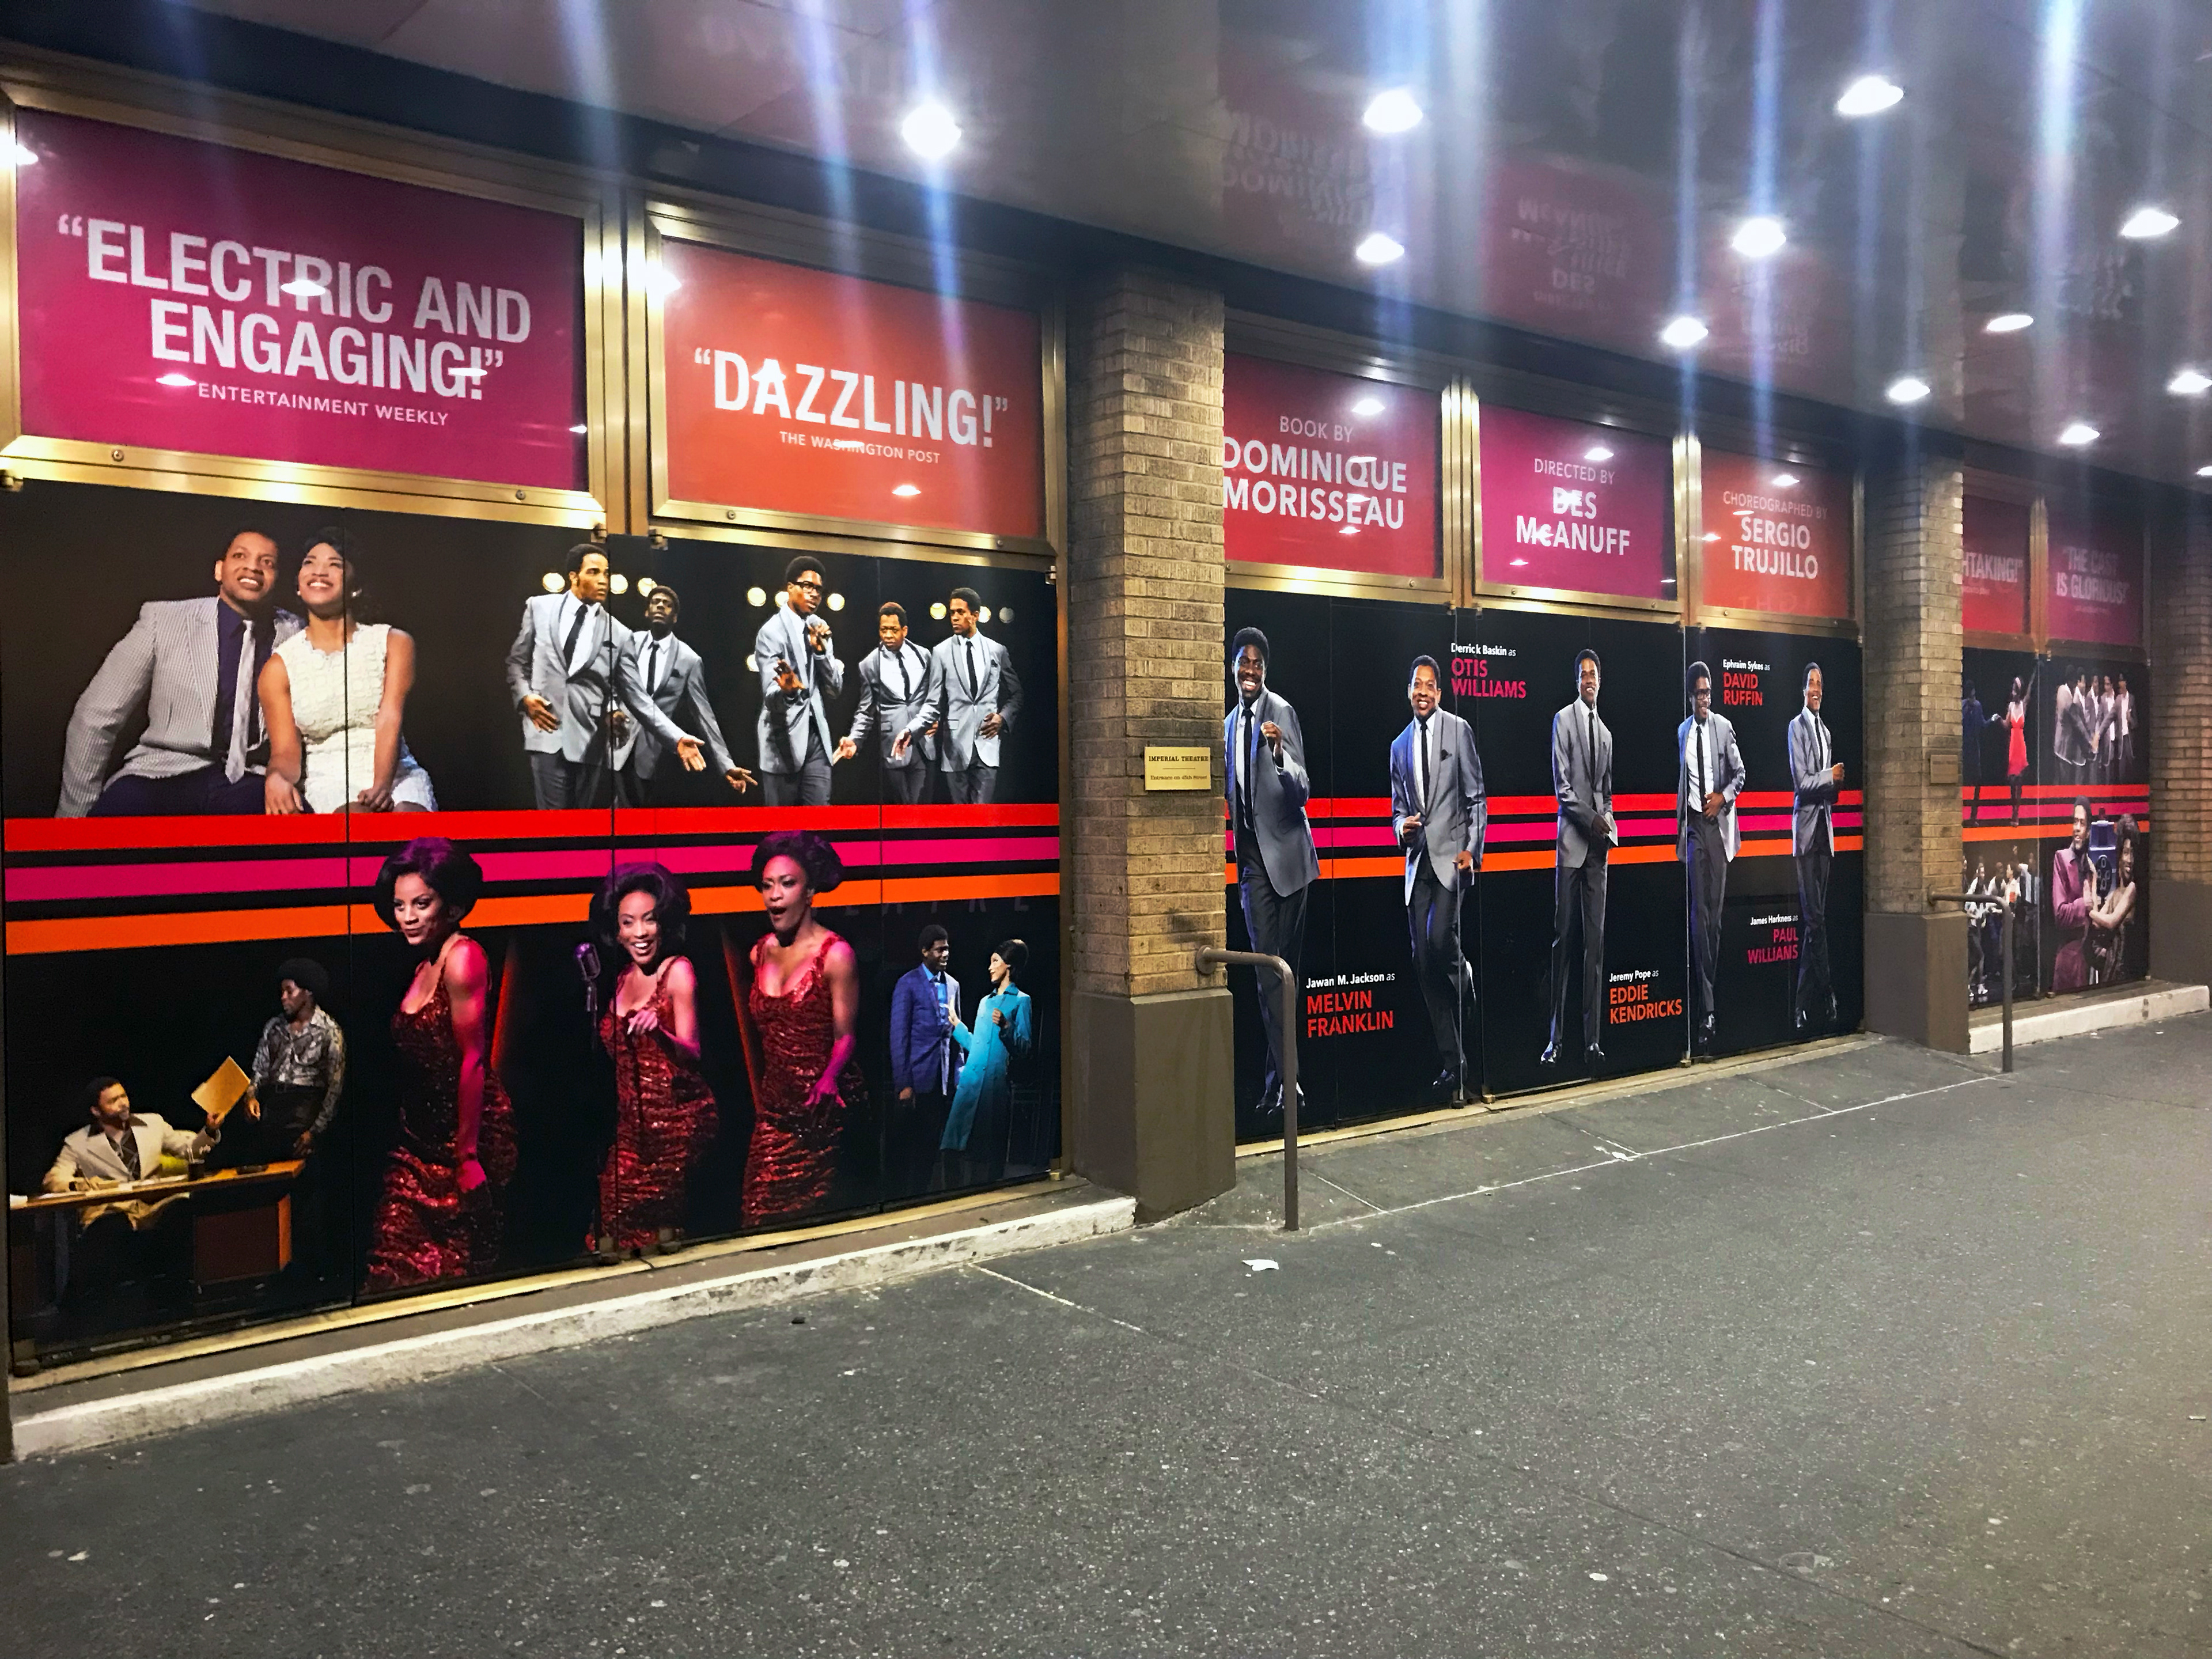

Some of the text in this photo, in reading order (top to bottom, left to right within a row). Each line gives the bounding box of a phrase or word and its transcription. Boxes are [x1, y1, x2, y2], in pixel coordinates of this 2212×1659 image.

[59, 214, 531, 343] “ELECTRIC AND
[151, 299, 503, 401] ENGAGING!”
[198, 382, 449, 426] ENTERTAINMENT WEEKLY
[694, 347, 1008, 448] “DAZZLING!”
[1279, 415, 1354, 443] BOOK BY
[779, 431, 806, 446] THE
[907, 449, 940, 464] POST
[1224, 436, 1407, 493] DOMINIQUE
[1535, 458, 1615, 485] DIRECTED BY
[1224, 476, 1404, 529] MORISSEAU
[1553, 486, 1597, 520] DES
[1723, 490, 1828, 520] CHOREOGRAPHED BY
[1516, 515, 1631, 555] McANUFF
[1741, 516, 1810, 550] SERGIO
[1731, 545, 1819, 579] TRUJILLO
[2056, 571, 2068, 597] IS
[1450, 642, 1517, 657] Derrick Baskin as
[1451, 657, 1488, 677] OTIS
[1723, 658, 1747, 671] Ephraim
[1747, 661, 1764, 672] Sykes
[1450, 677, 1527, 699] WILLIAMS
[1723, 672, 1759, 689] DAVID
[1724, 690, 1763, 706] RUFFIN
[1750, 916, 1767, 926] James
[1768, 914, 1792, 923] Harkness
[1773, 927, 1799, 943] PAUL
[1747, 944, 1799, 964] WILLIAMS
[1306, 972, 1396, 989] Jawan M. Jackson as
[1609, 972, 1634, 983] Jeremy
[1634, 970, 1652, 981] Pope
[1307, 990, 1372, 1015] MELVIN
[1609, 984, 1649, 1005] EDDIE
[1307, 1010, 1394, 1038] FRANKLIN
[1609, 998, 1682, 1024] KENDRICKS
